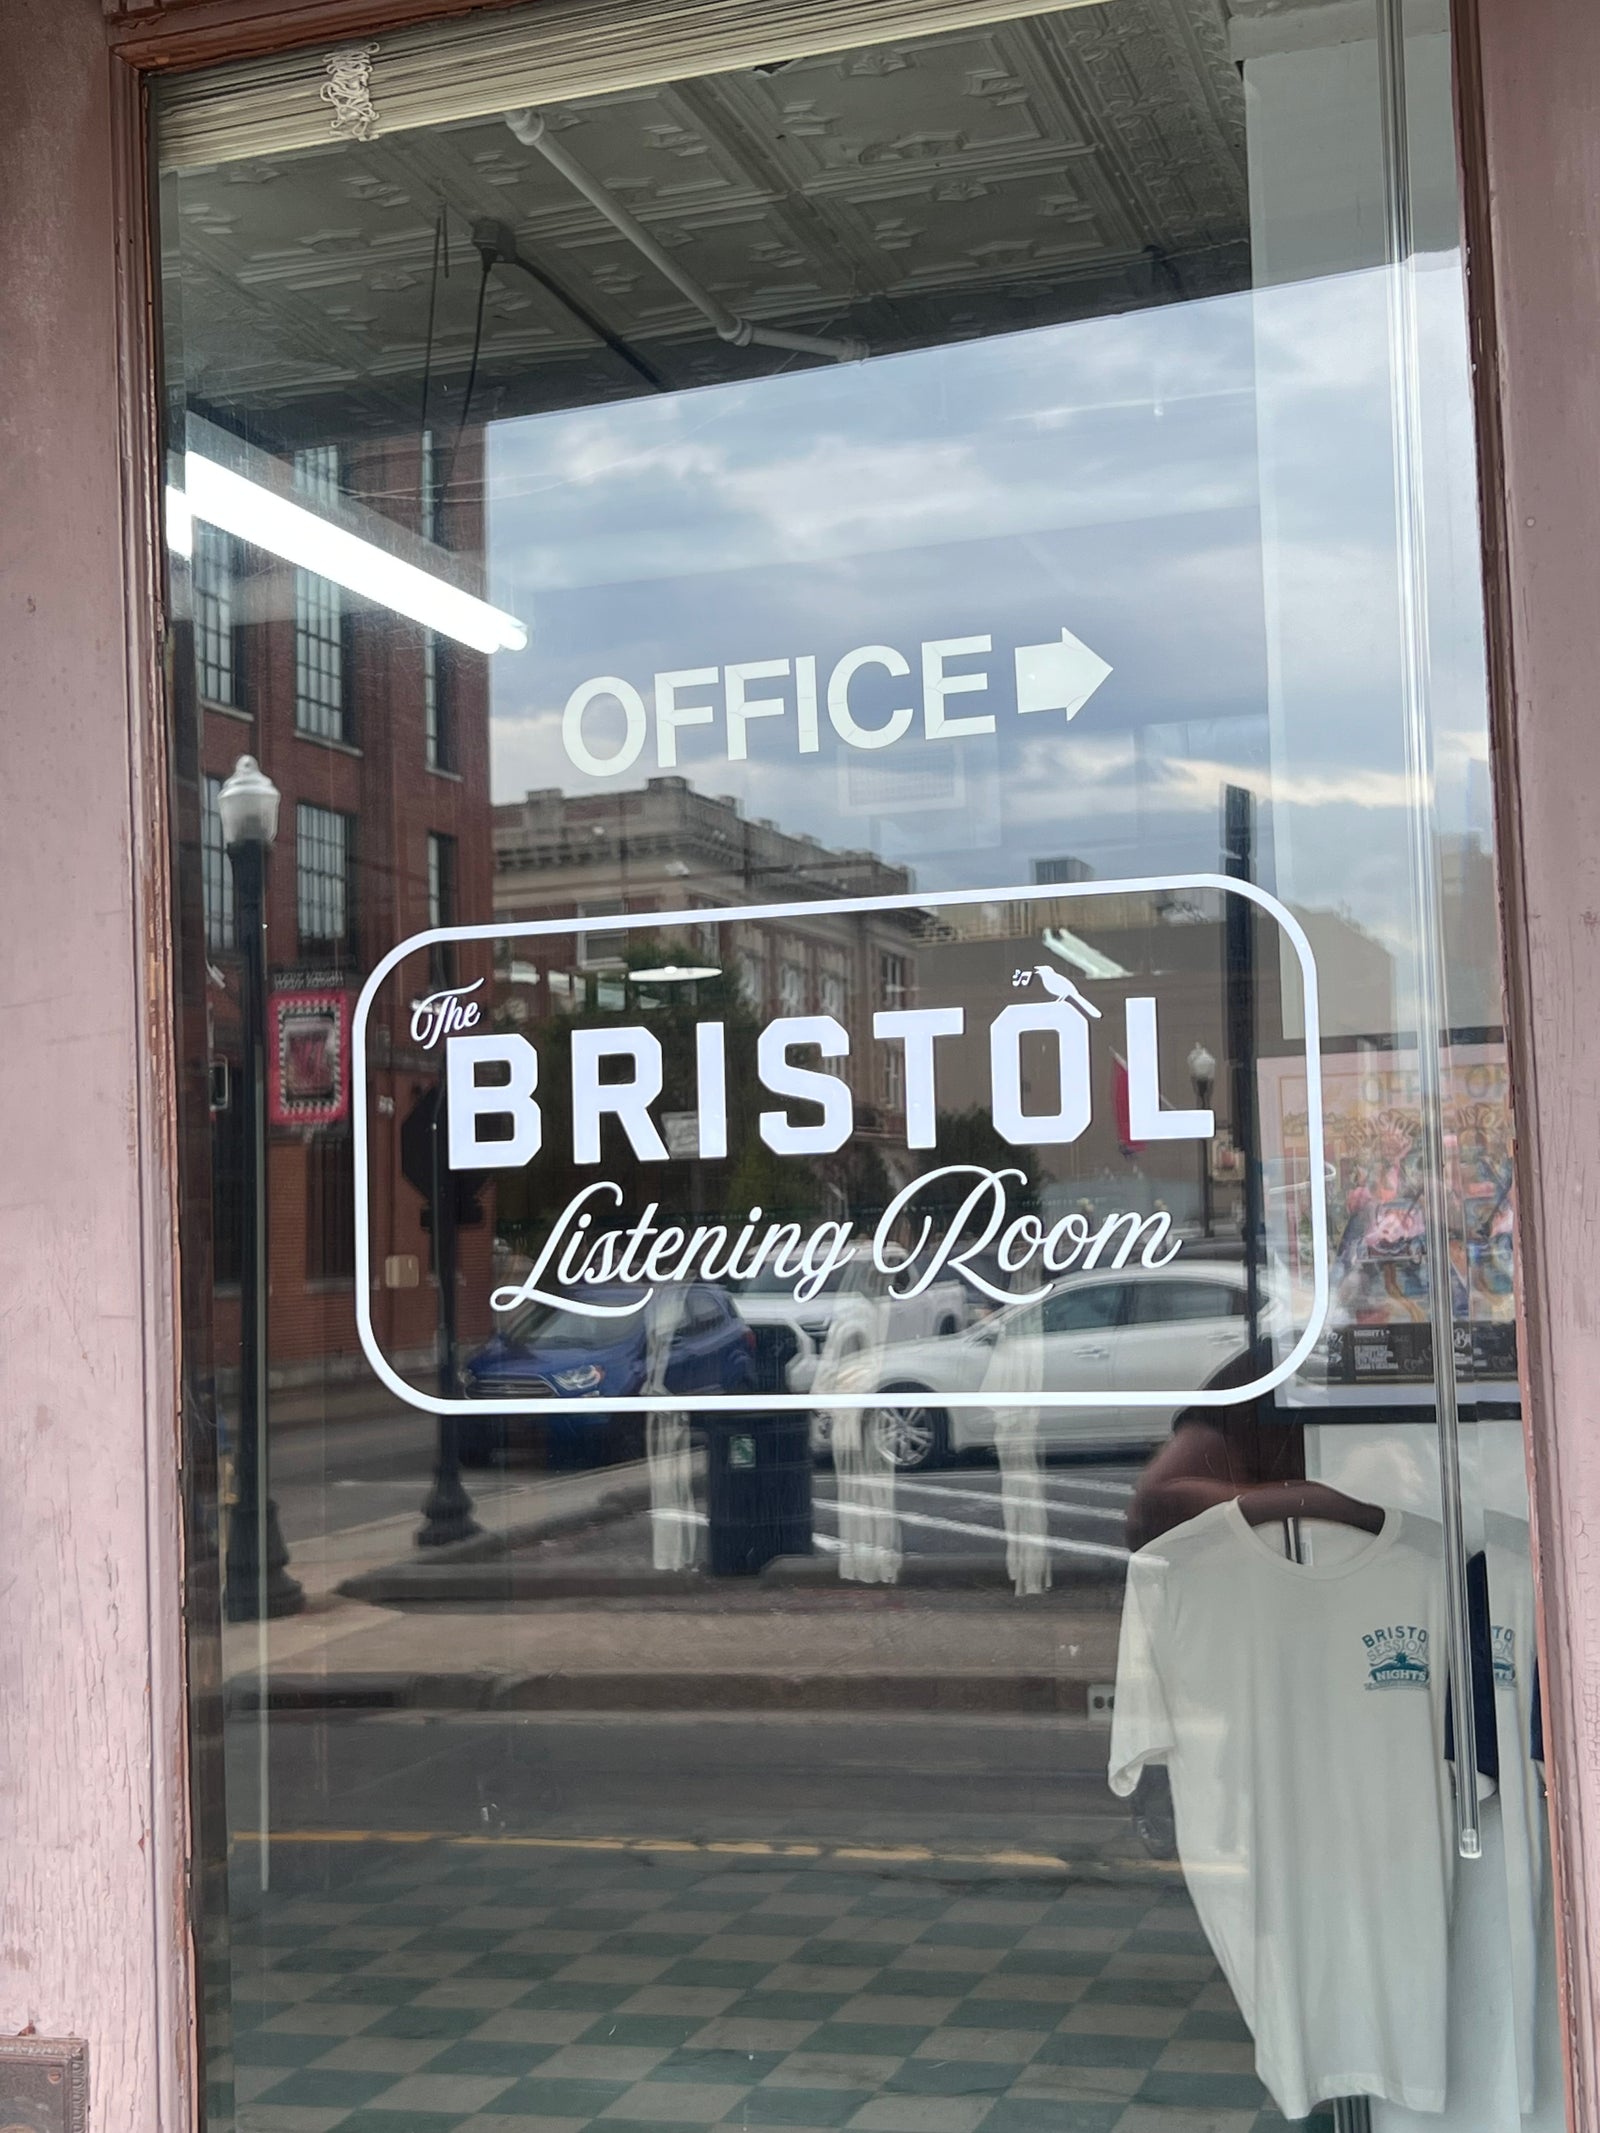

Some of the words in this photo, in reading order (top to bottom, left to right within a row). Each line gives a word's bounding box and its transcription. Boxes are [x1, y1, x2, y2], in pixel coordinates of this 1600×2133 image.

[562, 634, 996, 777] OFFICE
[410, 977, 484, 1050] The
[446, 997, 1215, 1170] BRISTOL
[490, 1181, 856, 1317] Listening
[871, 1164, 1182, 1304] Room
[1361, 1625, 1428, 1648] BRISTO
[1375, 1669, 1427, 1682] NIGHTS
